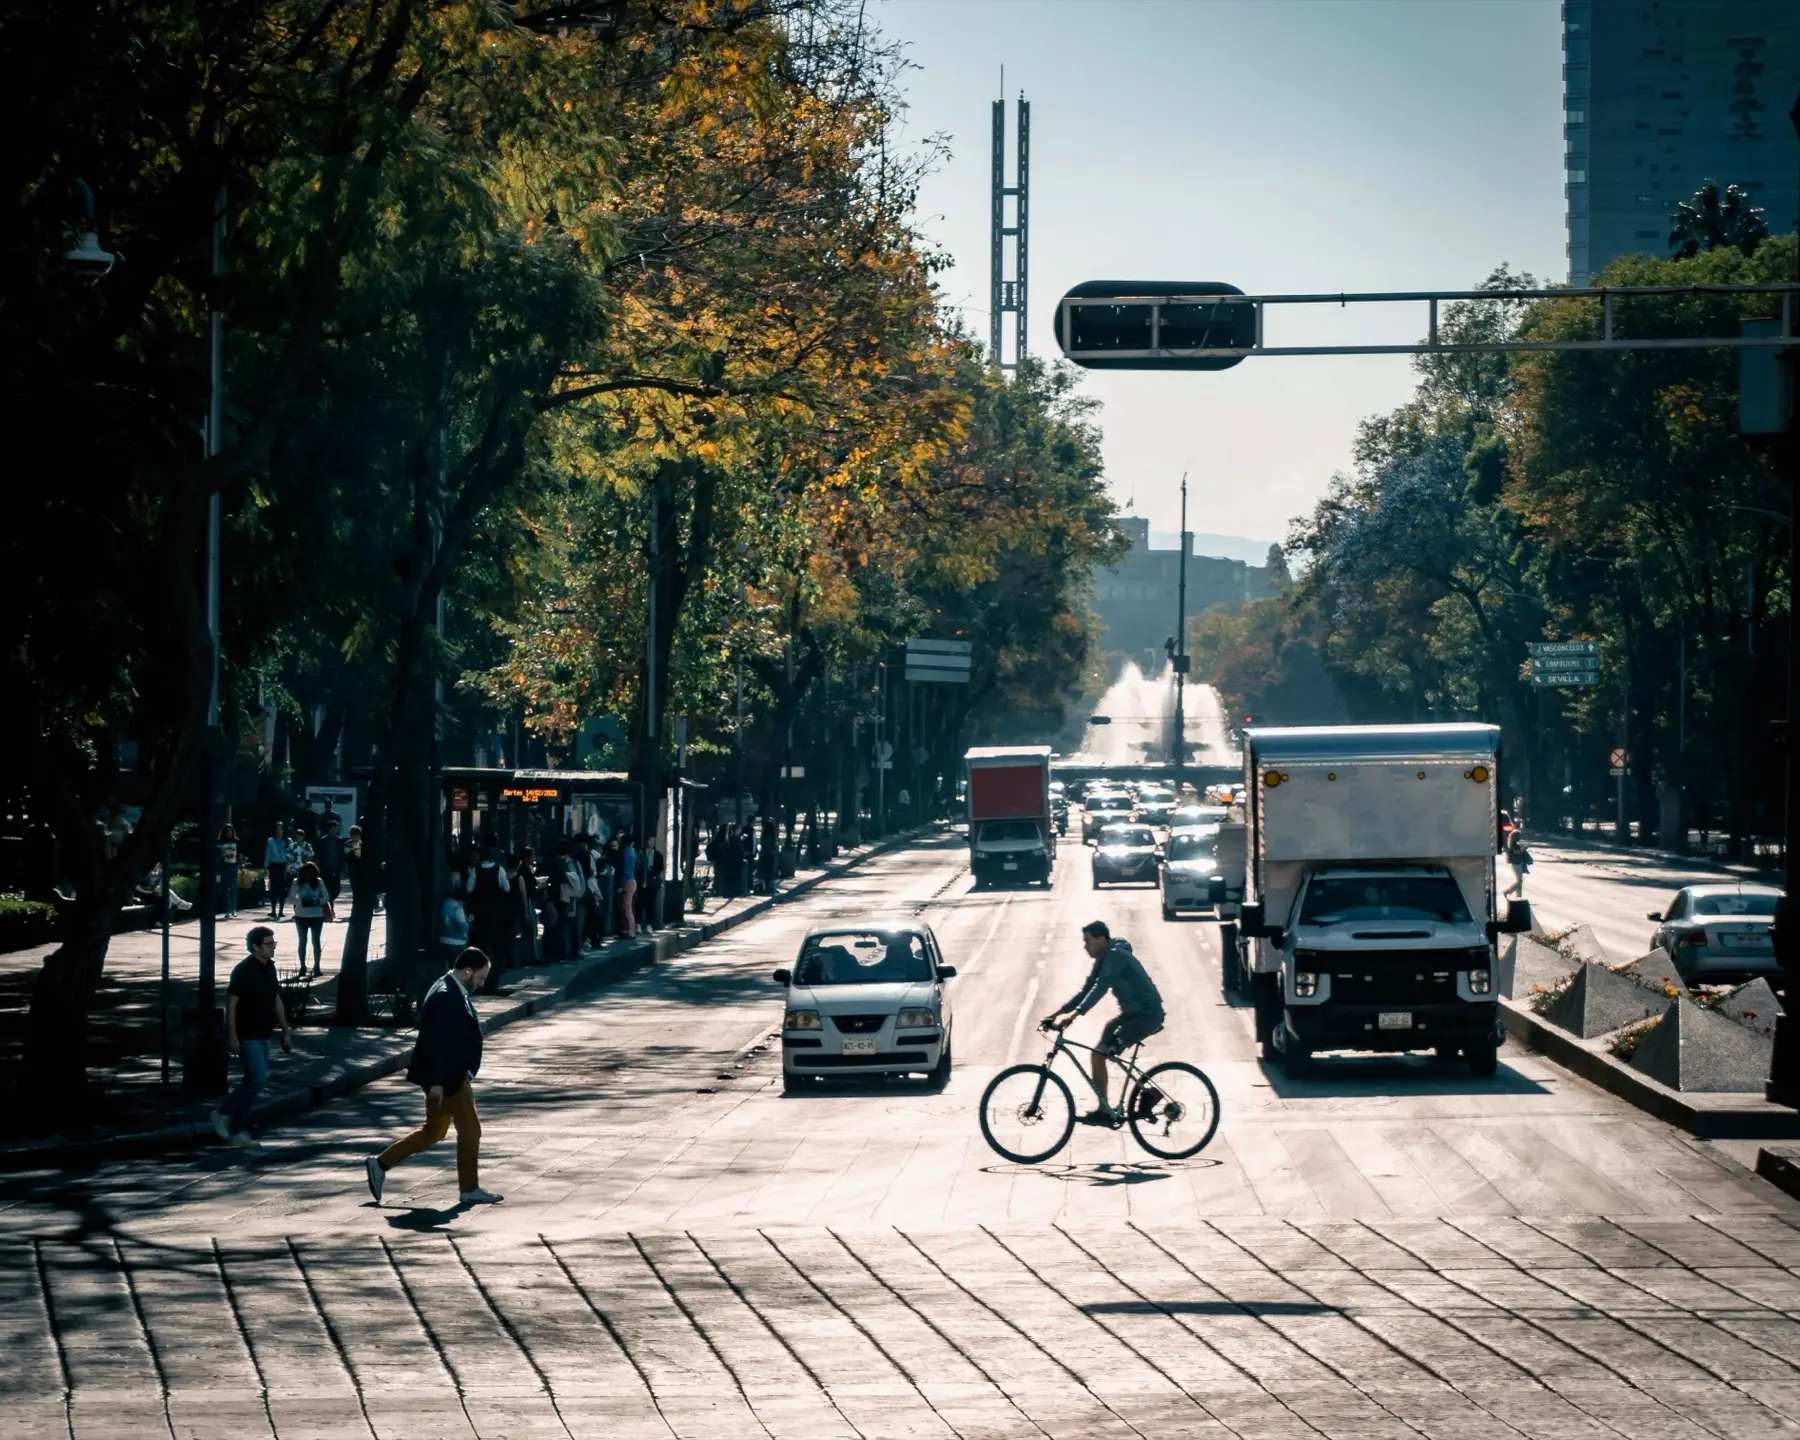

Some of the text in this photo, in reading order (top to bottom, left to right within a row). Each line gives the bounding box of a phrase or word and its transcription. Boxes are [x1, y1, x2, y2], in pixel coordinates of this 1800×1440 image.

[1543, 644, 1584, 652] VASCONCELOS
[1545, 660, 1580, 668] CHAPULTEPEC
[1547, 675, 1580, 683] SEVILLA
